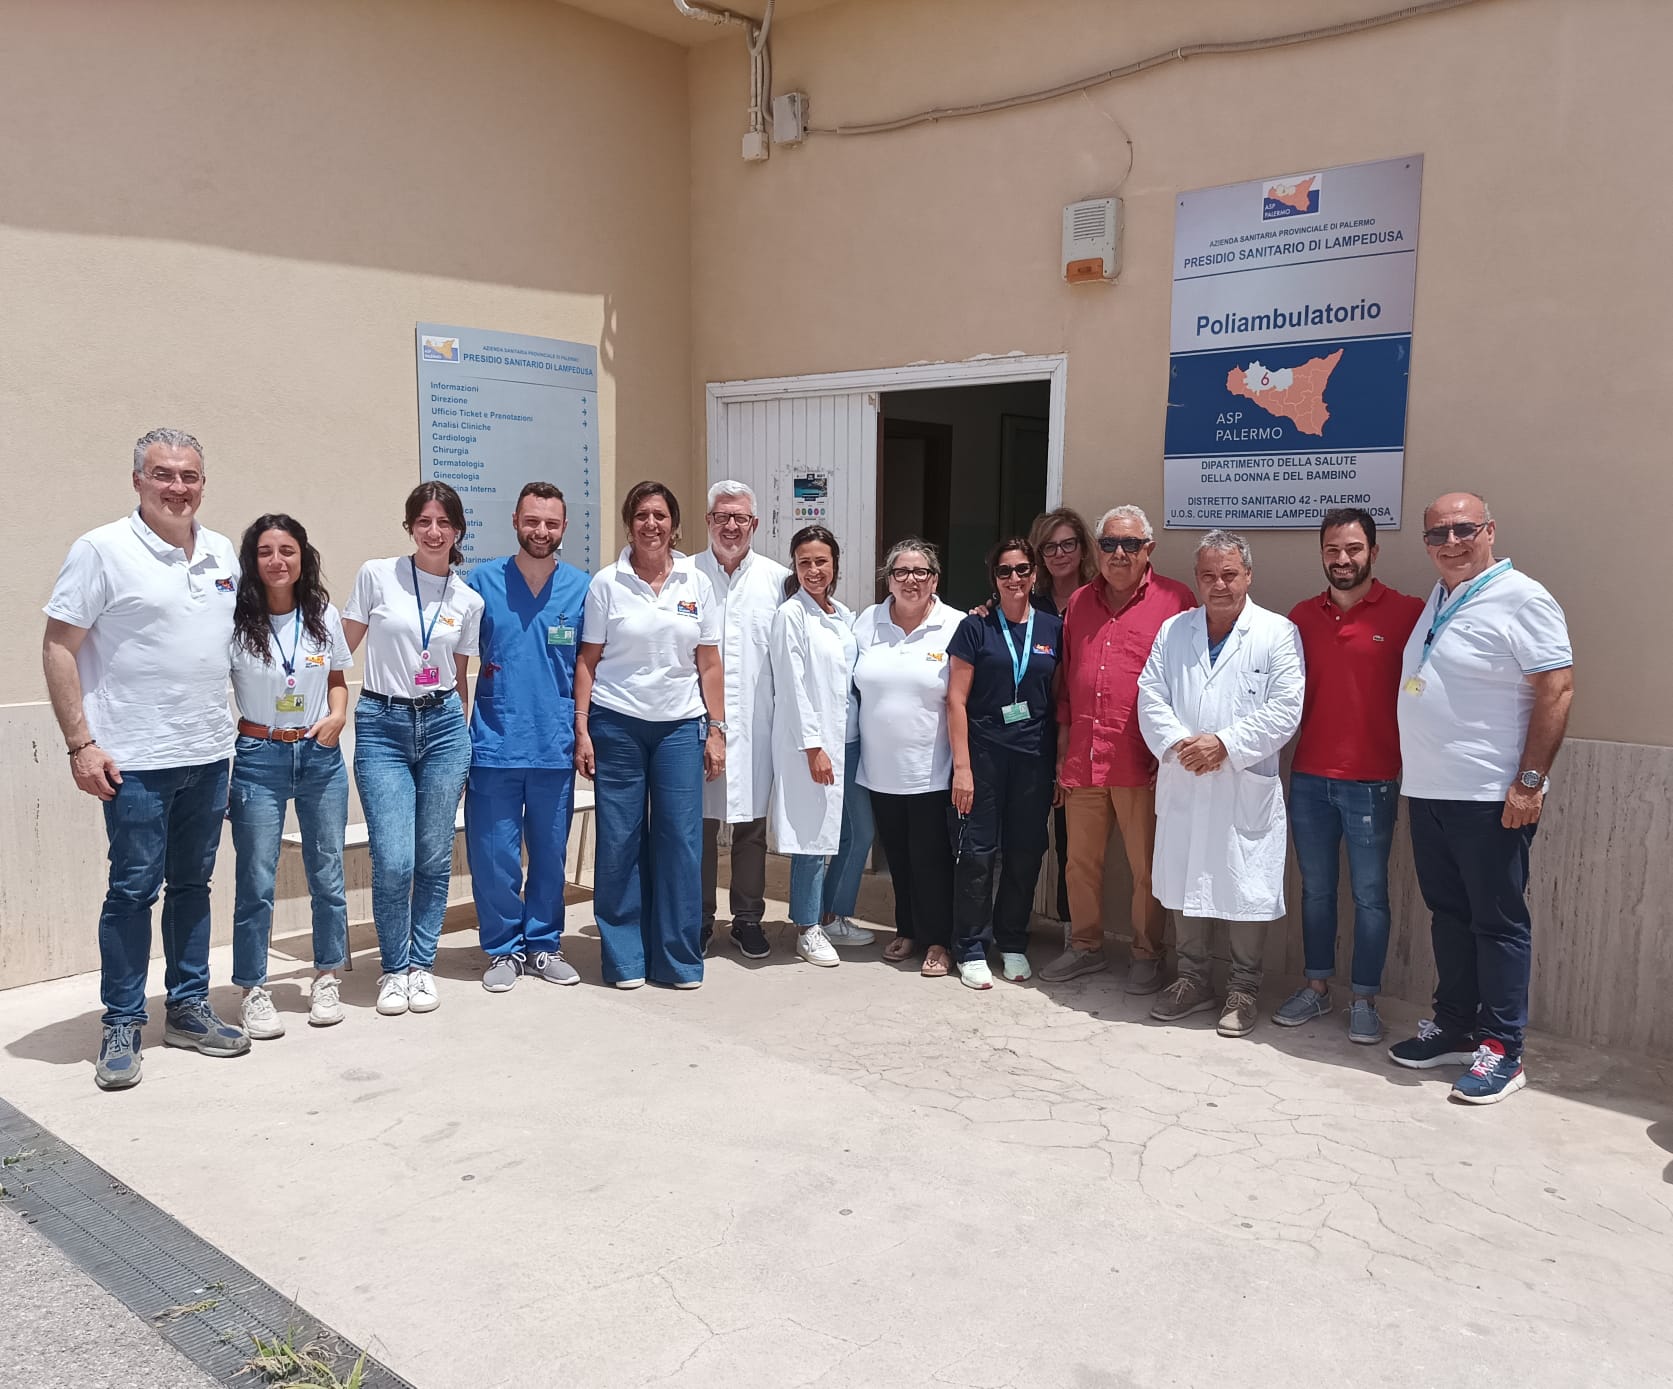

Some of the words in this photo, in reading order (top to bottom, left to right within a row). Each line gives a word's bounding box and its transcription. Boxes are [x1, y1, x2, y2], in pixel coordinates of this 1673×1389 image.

[1264, 208, 1291, 218] PALERMO
[1209, 236, 1239, 248] AZIENDA
[1240, 230, 1277, 244] SANITARIA
[1278, 224, 1329, 238] PROVINCIALE
[1330, 222, 1338, 231] DI
[1339, 218, 1376, 230] PALERMO
[1184, 251, 1236, 269] PRESIDIO
[1238, 242, 1305, 261] SANITARIO
[1308, 239, 1321, 251] DI
[1325, 230, 1404, 250] LAMPEDUSA
[1196, 298, 1382, 336] Poliambulatorio
[464, 354, 502, 364] PRESIDIO
[504, 358, 544, 369] SANITARIO
[554, 364, 594, 376] LAMPEDUSA
[1260, 372, 1270, 386] 6
[430, 382, 479, 392] Informazioni
[431, 394, 468, 404] Direzione
[432, 408, 458, 416] Ufficio
[460, 409, 482, 418] Ticket
[490, 412, 534, 422] Prenotazioni
[1216, 412, 1243, 425] ASP
[432, 420, 458, 429] Analisi
[460, 422, 492, 431] Cliniche
[432, 432, 476, 444] Cardiologia
[1216, 427, 1283, 441] PALERMO
[432, 446, 468, 456] Chirurgia
[433, 458, 484, 470] Dermatologia
[1201, 458, 1274, 470] DIPARTIMENTO
[1277, 457, 1312, 468] DELLA
[1314, 456, 1357, 466] SALUTE
[434, 472, 480, 482] Ginecologia
[1201, 472, 1232, 483] DELLA
[1234, 472, 1270, 482] DONNA
[1273, 472, 1280, 481] E
[1283, 471, 1304, 481] DEL
[1306, 470, 1357, 480] BAMBINO
[470, 485, 496, 493] Interna
[1188, 496, 1239, 506] DISTRETTO
[1241, 496, 1296, 506] SANITARIO
[1298, 496, 1311, 504] 42
[1320, 494, 1371, 504] PALERMO
[1170, 510, 1196, 518] U.O.S.
[1197, 509, 1222, 518] CURE
[1225, 509, 1273, 519] PRIMARIE
[1276, 508, 1327, 518] LAMPEDU
